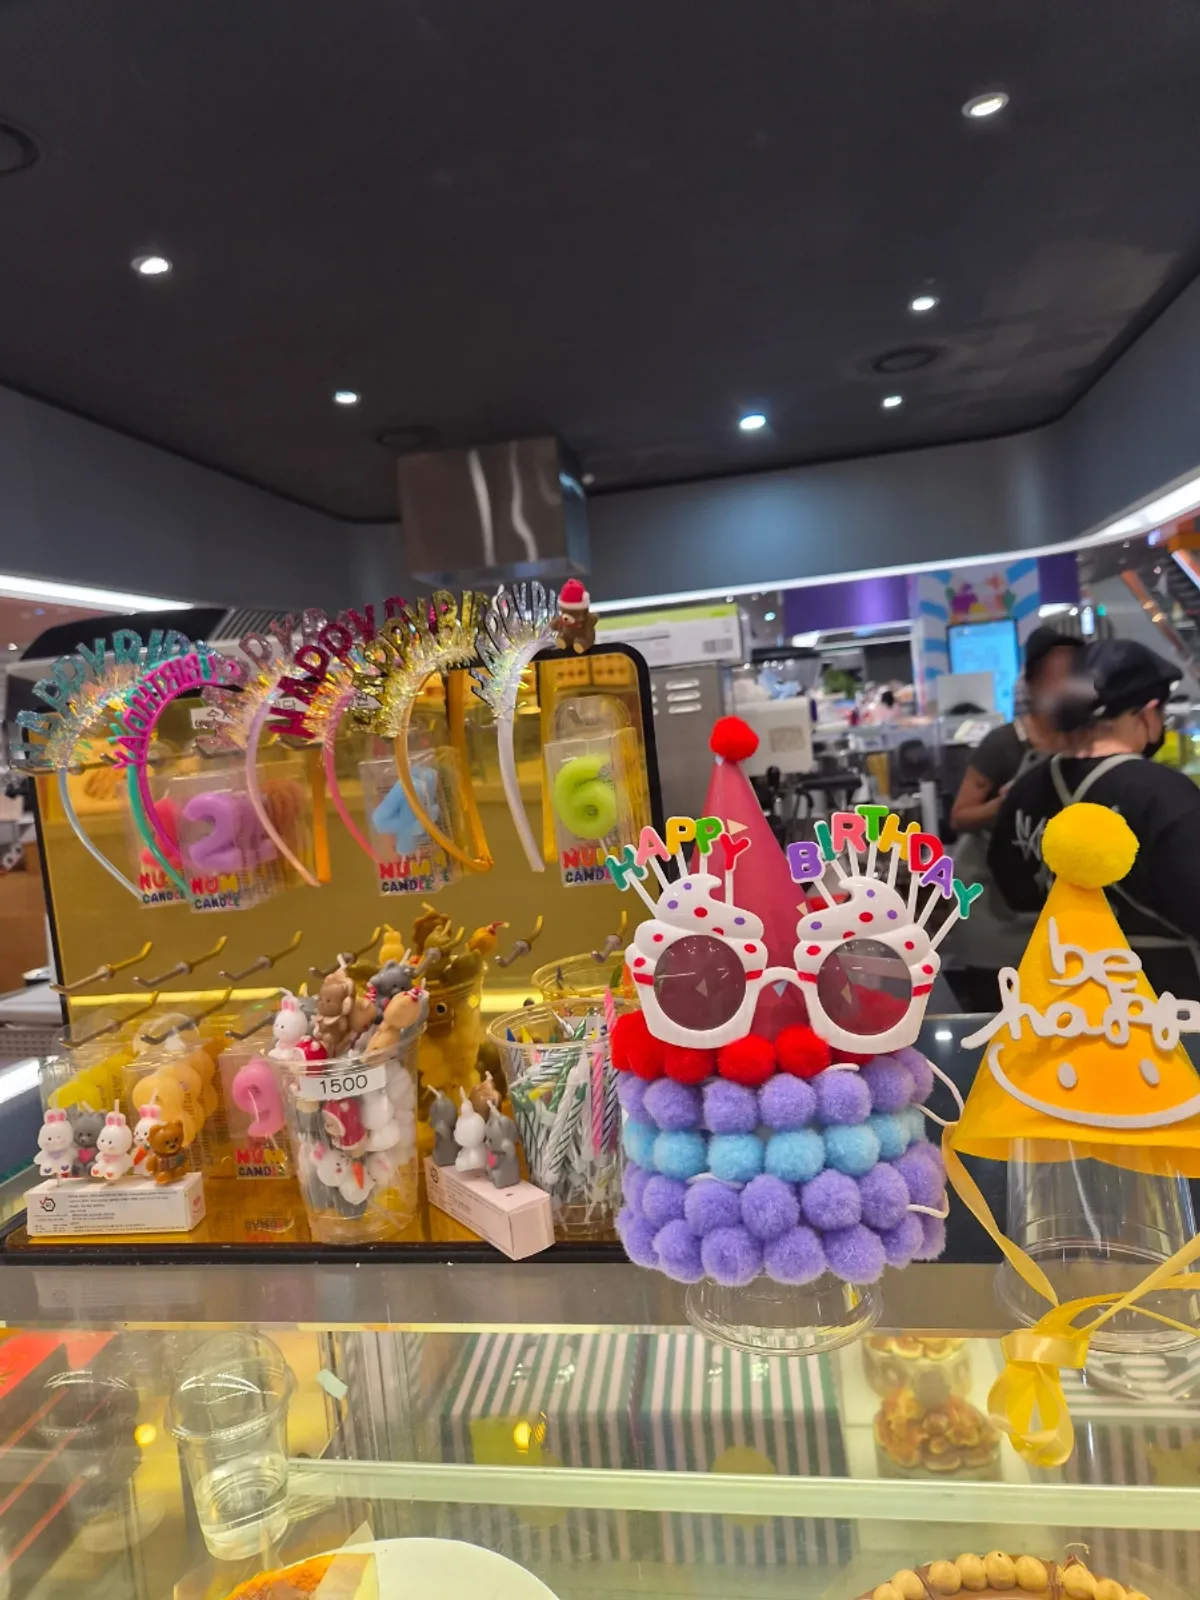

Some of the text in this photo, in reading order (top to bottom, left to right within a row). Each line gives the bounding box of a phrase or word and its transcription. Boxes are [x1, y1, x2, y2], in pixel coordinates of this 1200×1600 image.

[605, 816, 751, 892] HAPPY
[786, 804, 983, 919] BIRTHDAY
[191, 872, 239, 895] NUM
[382, 878, 433, 892] CANDLE
[1048, 915, 1143, 989] be
[319, 1074, 368, 1094] 1500
